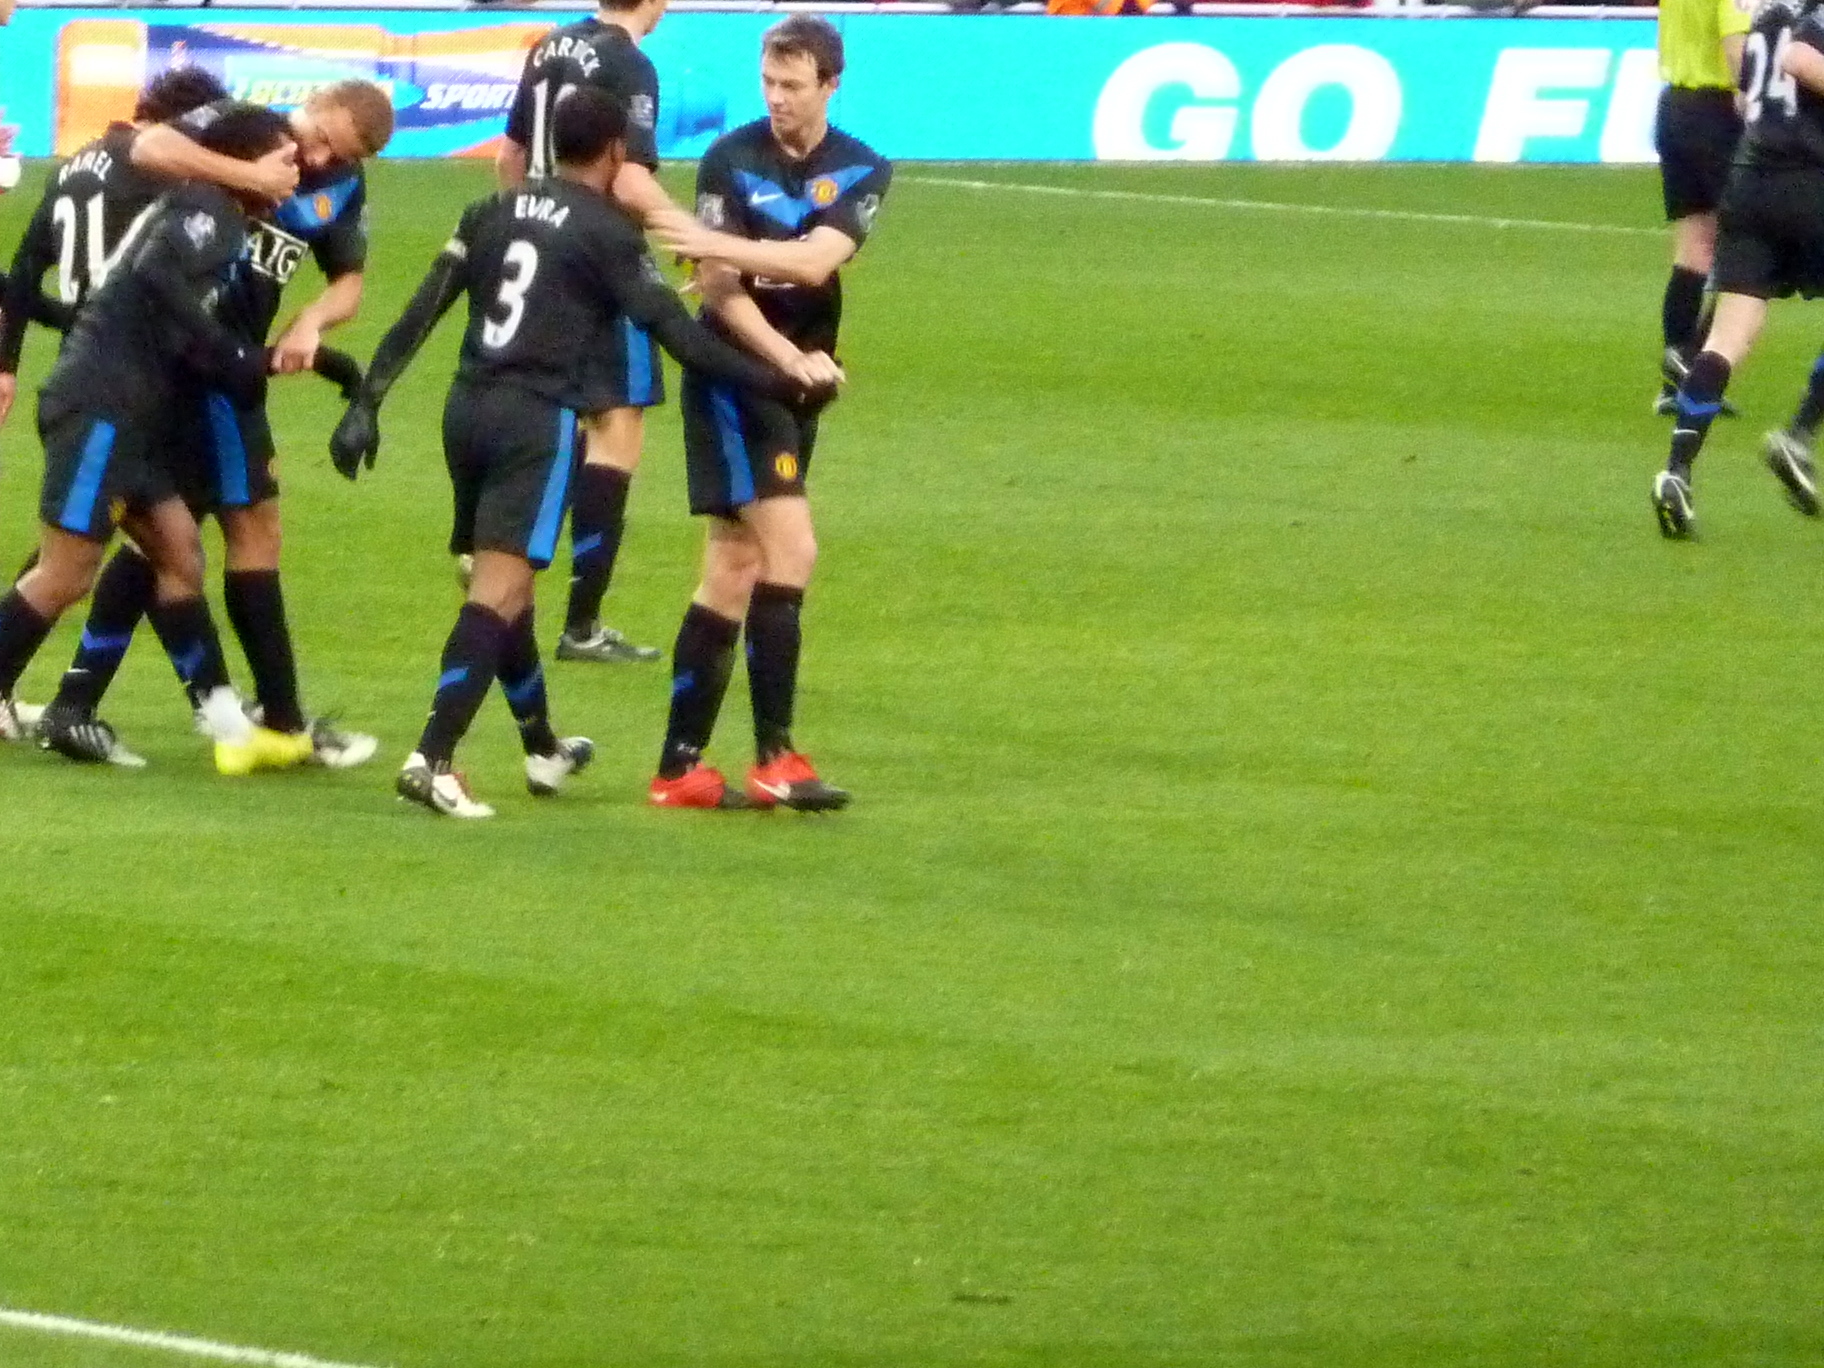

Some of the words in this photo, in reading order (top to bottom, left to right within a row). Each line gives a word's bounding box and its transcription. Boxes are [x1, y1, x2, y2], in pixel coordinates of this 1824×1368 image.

[419, 82, 518, 110] SPORT
[527, 77, 578, 179] 1
[1092, 42, 1403, 162] GO
[514, 194, 571, 229] EVRA
[482, 239, 539, 350] 3
